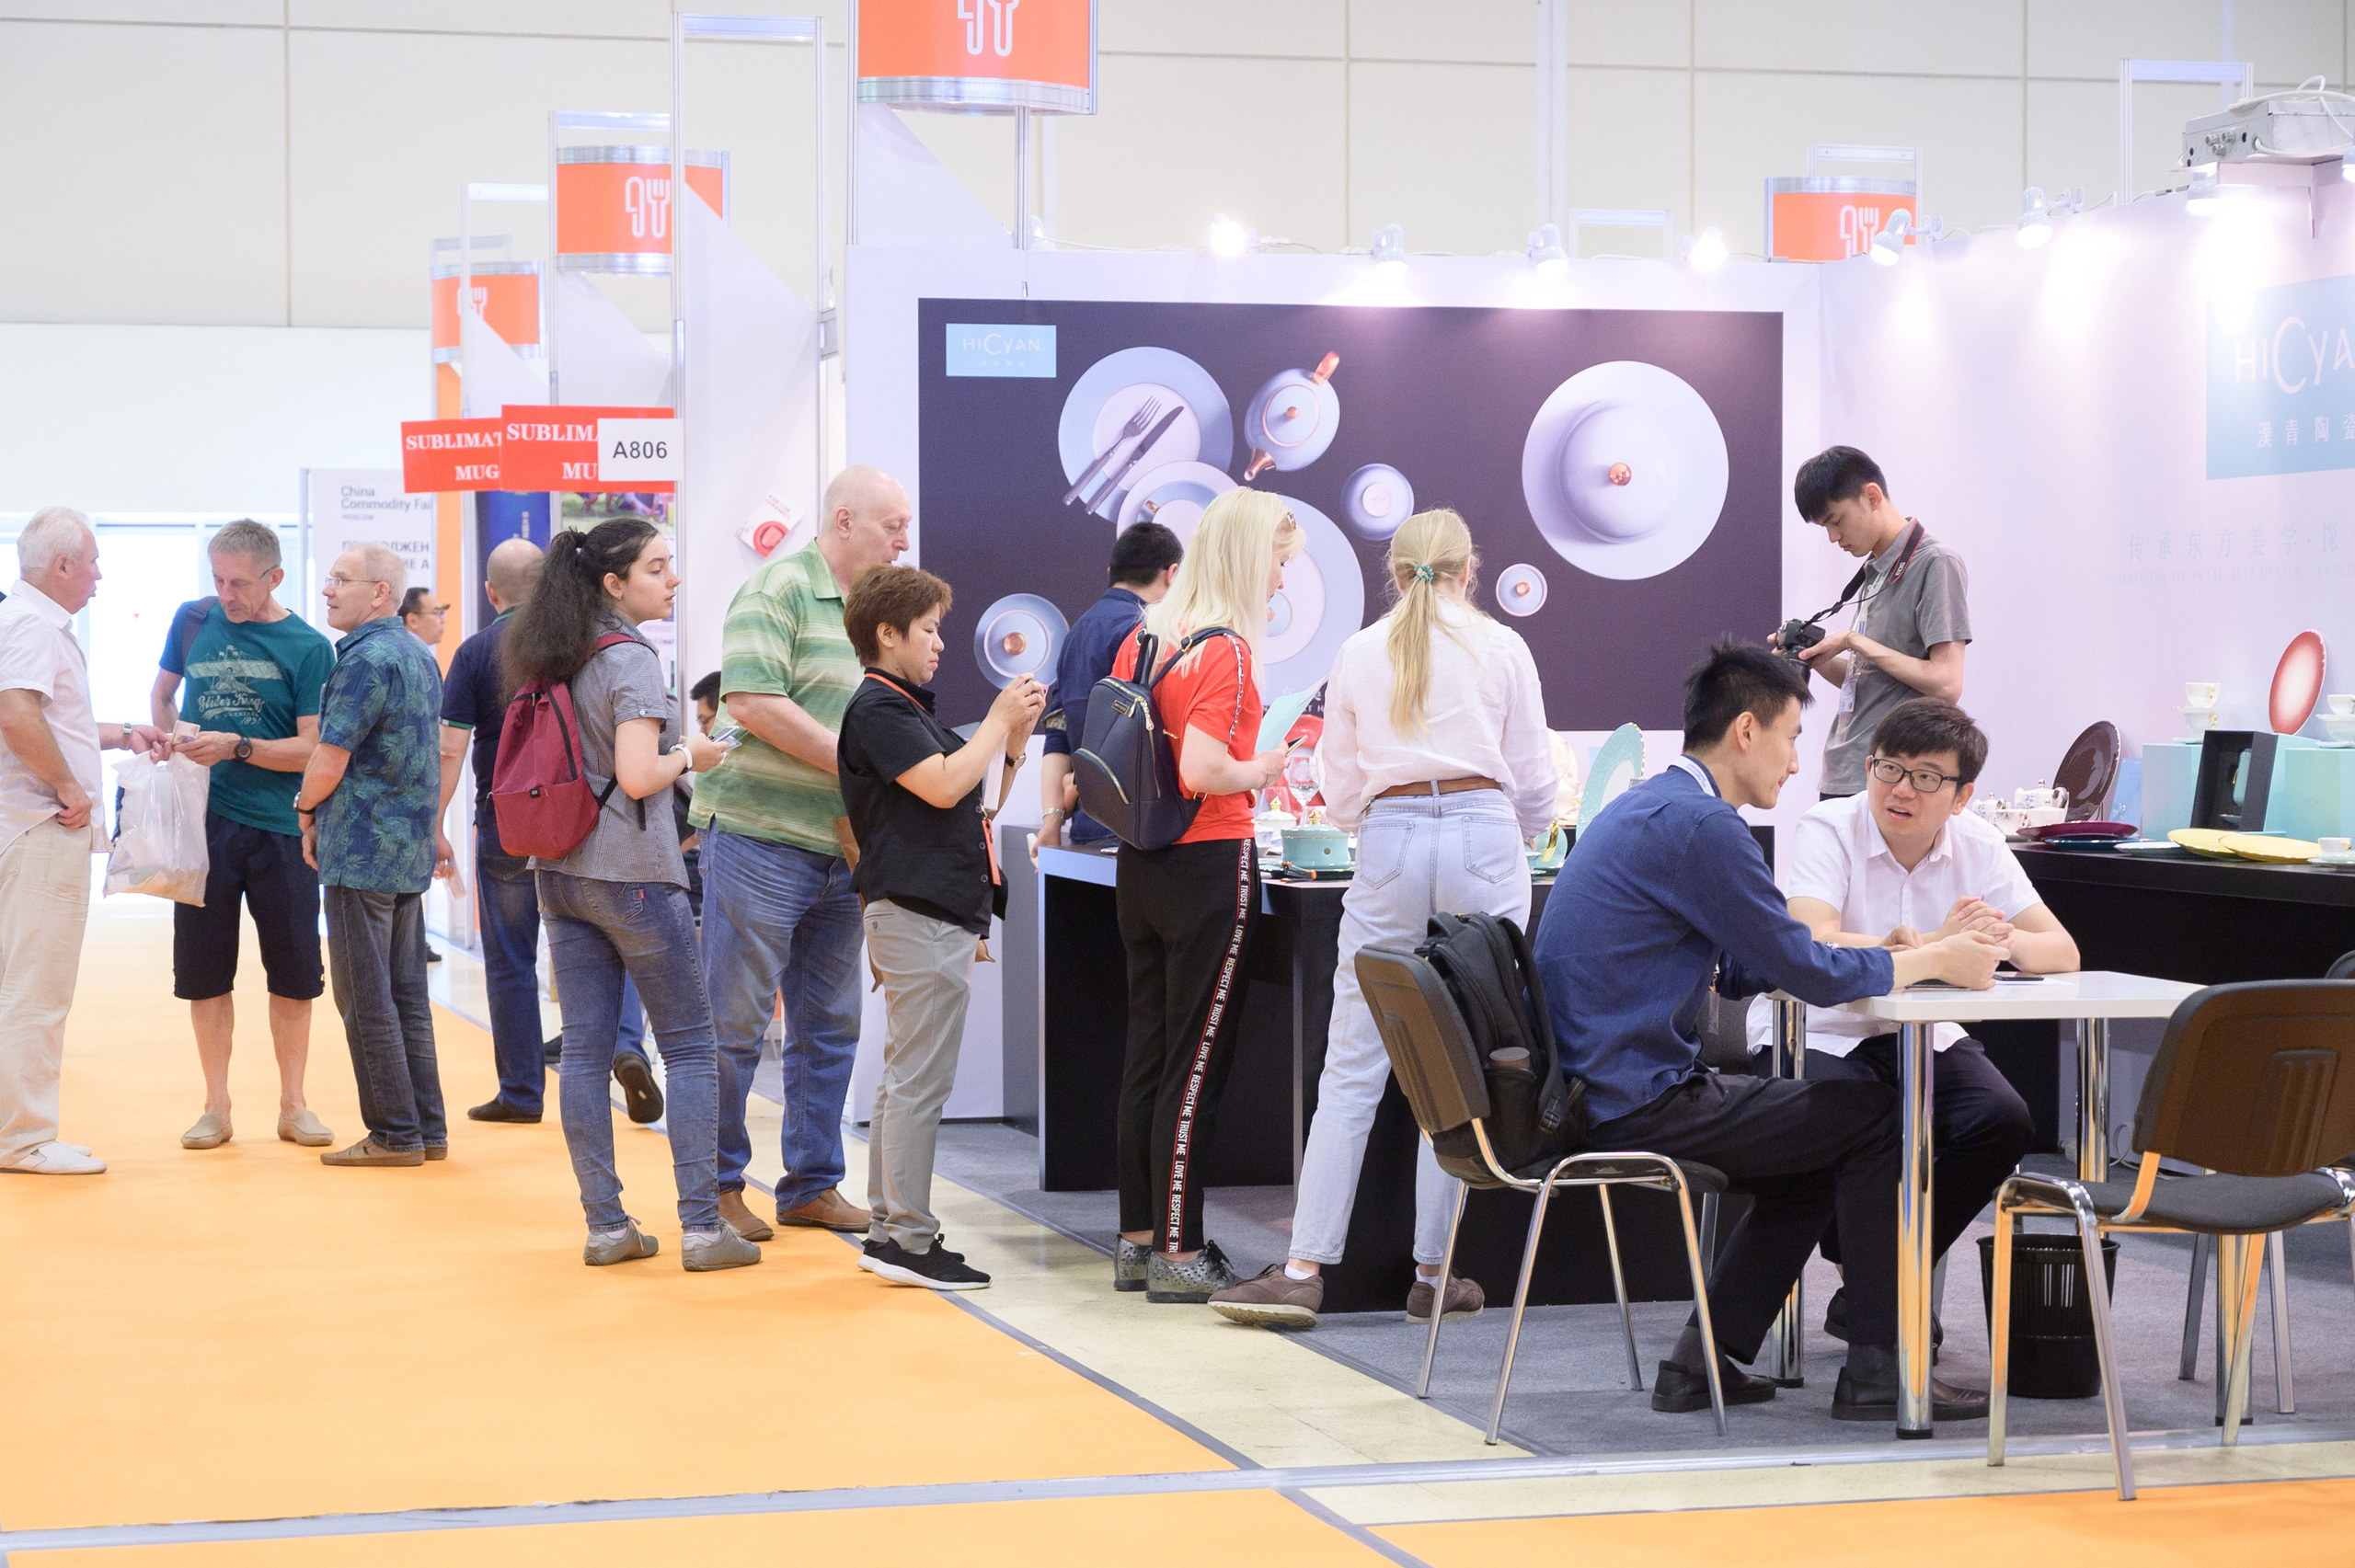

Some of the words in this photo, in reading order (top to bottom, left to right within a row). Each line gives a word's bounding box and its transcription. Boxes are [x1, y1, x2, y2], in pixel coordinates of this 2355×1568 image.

[612, 441, 668, 460] A806
[454, 464, 500, 481] MUG
[340, 485, 375, 497] China
[340, 497, 410, 511] Commodity
[342, 541, 430, 553] ПЛЖЕН
[197, 695, 231, 713] Glider
[1241, 870, 1248, 882] ME
[1240, 885, 1248, 910] TRUST
[1239, 909, 1246, 921] ME
[1234, 925, 1244, 944] LOVE
[1230, 943, 1239, 956] ME
[1220, 956, 1235, 990] RESPECT
[1216, 989, 1227, 1001] ME
[1210, 1002, 1223, 1026] TRUST
[1206, 1025, 1216, 1038] ME
[1199, 1041, 1211, 1061] LOVE
[1195, 1059, 1206, 1073] ME
[1186, 1074, 1201, 1106] RESPECT
[1183, 1104, 1193, 1118] ME
[1179, 1120, 1190, 1144] TRUST
[1177, 1143, 1187, 1156] ME
[1174, 1161, 1185, 1181] LOVE
[1173, 1180, 1183, 1192] ME
[1171, 1194, 1181, 1227] RESPECT
[1170, 1226, 1179, 1239] ME
